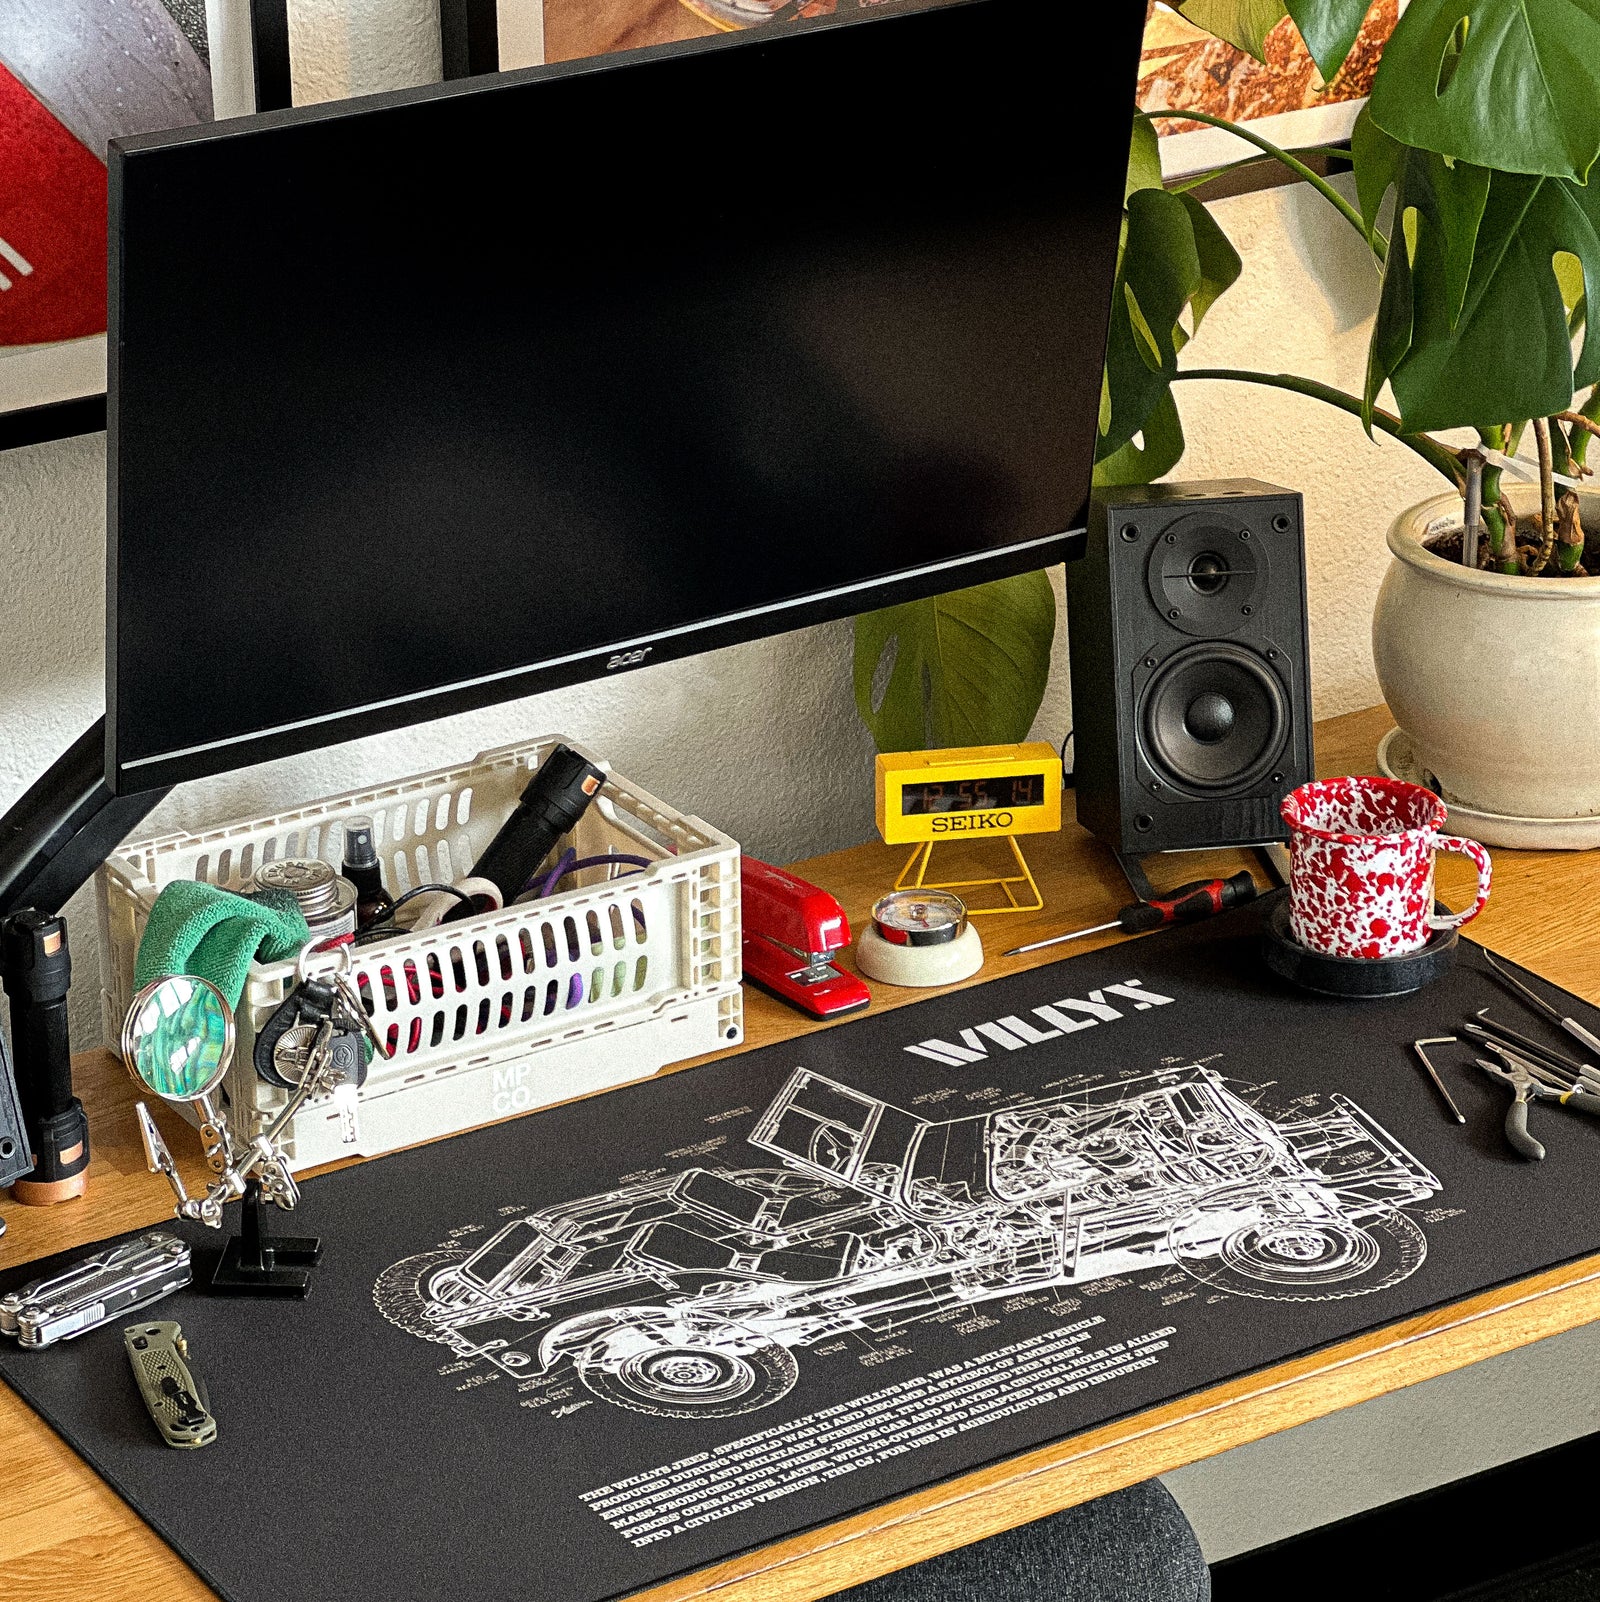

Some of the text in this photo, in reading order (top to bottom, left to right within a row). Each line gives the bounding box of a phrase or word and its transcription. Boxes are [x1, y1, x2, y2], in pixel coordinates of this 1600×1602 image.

[607, 646, 653, 670] acer
[932, 811, 1013, 833] SEIKO
[492, 1063, 531, 1093] MP
[903, 978, 1176, 1067] WILLYS
[577, 1485, 615, 1502] THE
[610, 1465, 672, 1490] WILLYS
[671, 1451, 717, 1471] JEEP,
[712, 1414, 816, 1456] SPECIFICALLY
[813, 1403, 849, 1420] THE
[844, 1385, 903, 1409] WILLYS
[971, 1335, 1046, 1365] MILITARY
[1041, 1314, 1107, 1340] VEHICLE
[588, 1478, 671, 1512] PRODUCED
[667, 1457, 731, 1484] DURING
[727, 1439, 783, 1462] WORLD
[832, 1410, 866, 1427] AND
[862, 1388, 928, 1416] BECAME
[936, 1365, 999, 1390] SYMBOL
[1015, 1331, 1092, 1363] AMERICAN
[598, 1477, 710, 1521] ENGINEERING
[709, 1465, 743, 1483] AND
[739, 1438, 818, 1471] MILITARY
[922, 1371, 1013, 1406] CONSIDERED
[1009, 1360, 1044, 1376] THE
[1039, 1345, 1084, 1366] FIRST
[680, 1478, 781, 1517] OPERATIONS.
[777, 1459, 836, 1483] LATER,
[830, 1410, 969, 1463] WILLYS-OVERLAND
[968, 1387, 1035, 1416] ADAPTED
[1031, 1376, 1066, 1392] THE
[1061, 1352, 1135, 1382] MILITARY
[1133, 1340, 1170, 1358] JEEP
[910, 1407, 943, 1424] AND
[939, 1387, 1000, 1413] PLAYED
[1009, 1363, 1073, 1388] CRUCIAL
[1068, 1349, 1110, 1368] ROLE
[1126, 1326, 1177, 1349] ALLIED
[630, 1529, 673, 1548] INTO
[683, 1498, 755, 1529] CIVILIAN
[821, 1462, 858, 1479] THE
[957, 1391, 1058, 1432] AGRICULTURE
[1057, 1380, 1090, 1397] AND
[1085, 1355, 1160, 1386] INDUSTRY
